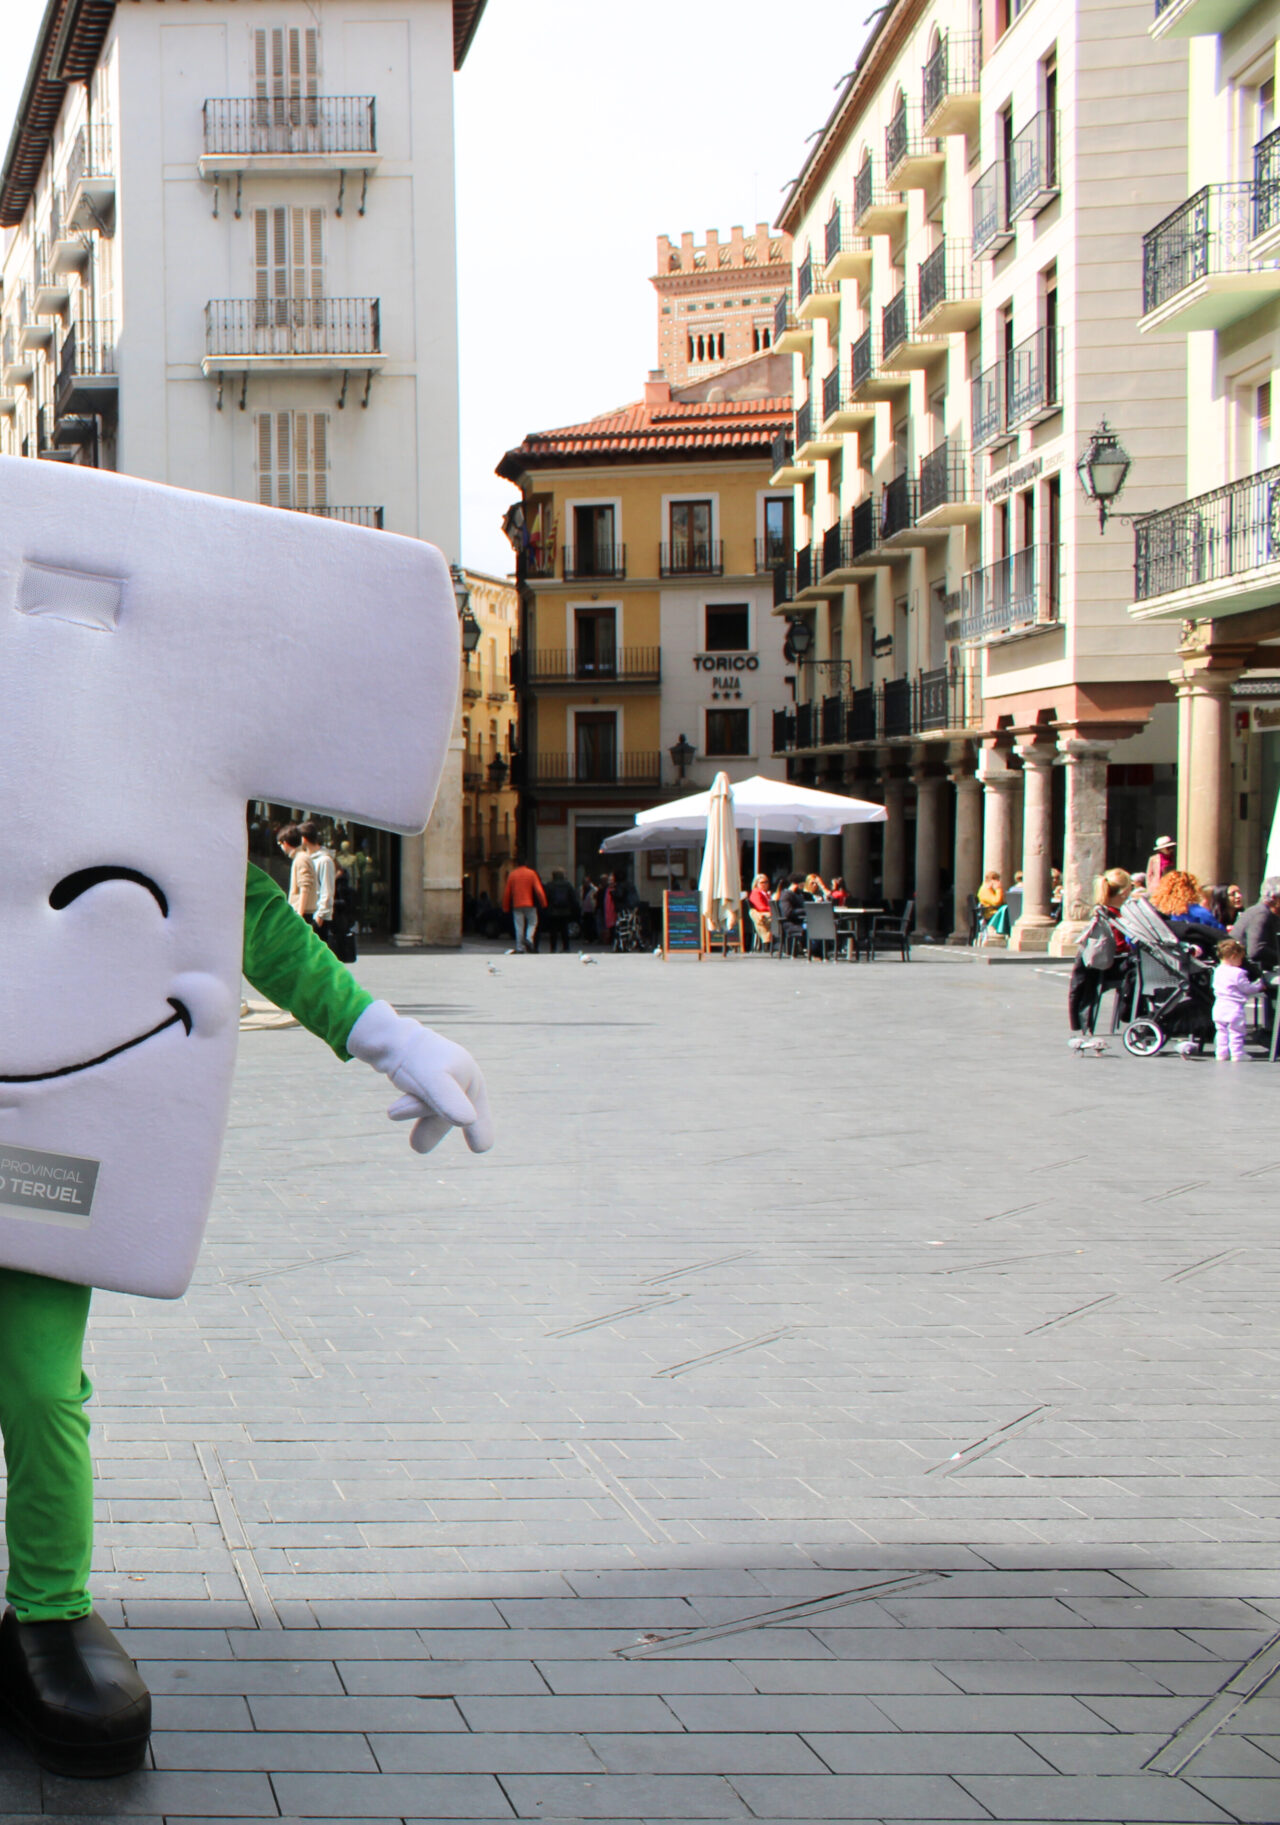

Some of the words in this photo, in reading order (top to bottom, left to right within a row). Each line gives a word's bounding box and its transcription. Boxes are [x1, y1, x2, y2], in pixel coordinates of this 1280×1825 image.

[693, 656, 759, 671] TORICO
[712, 676, 740, 689] PLAZA
[1, 1158, 84, 1184] PROVINCIAL
[10, 1178, 82, 1204] TERUEL
